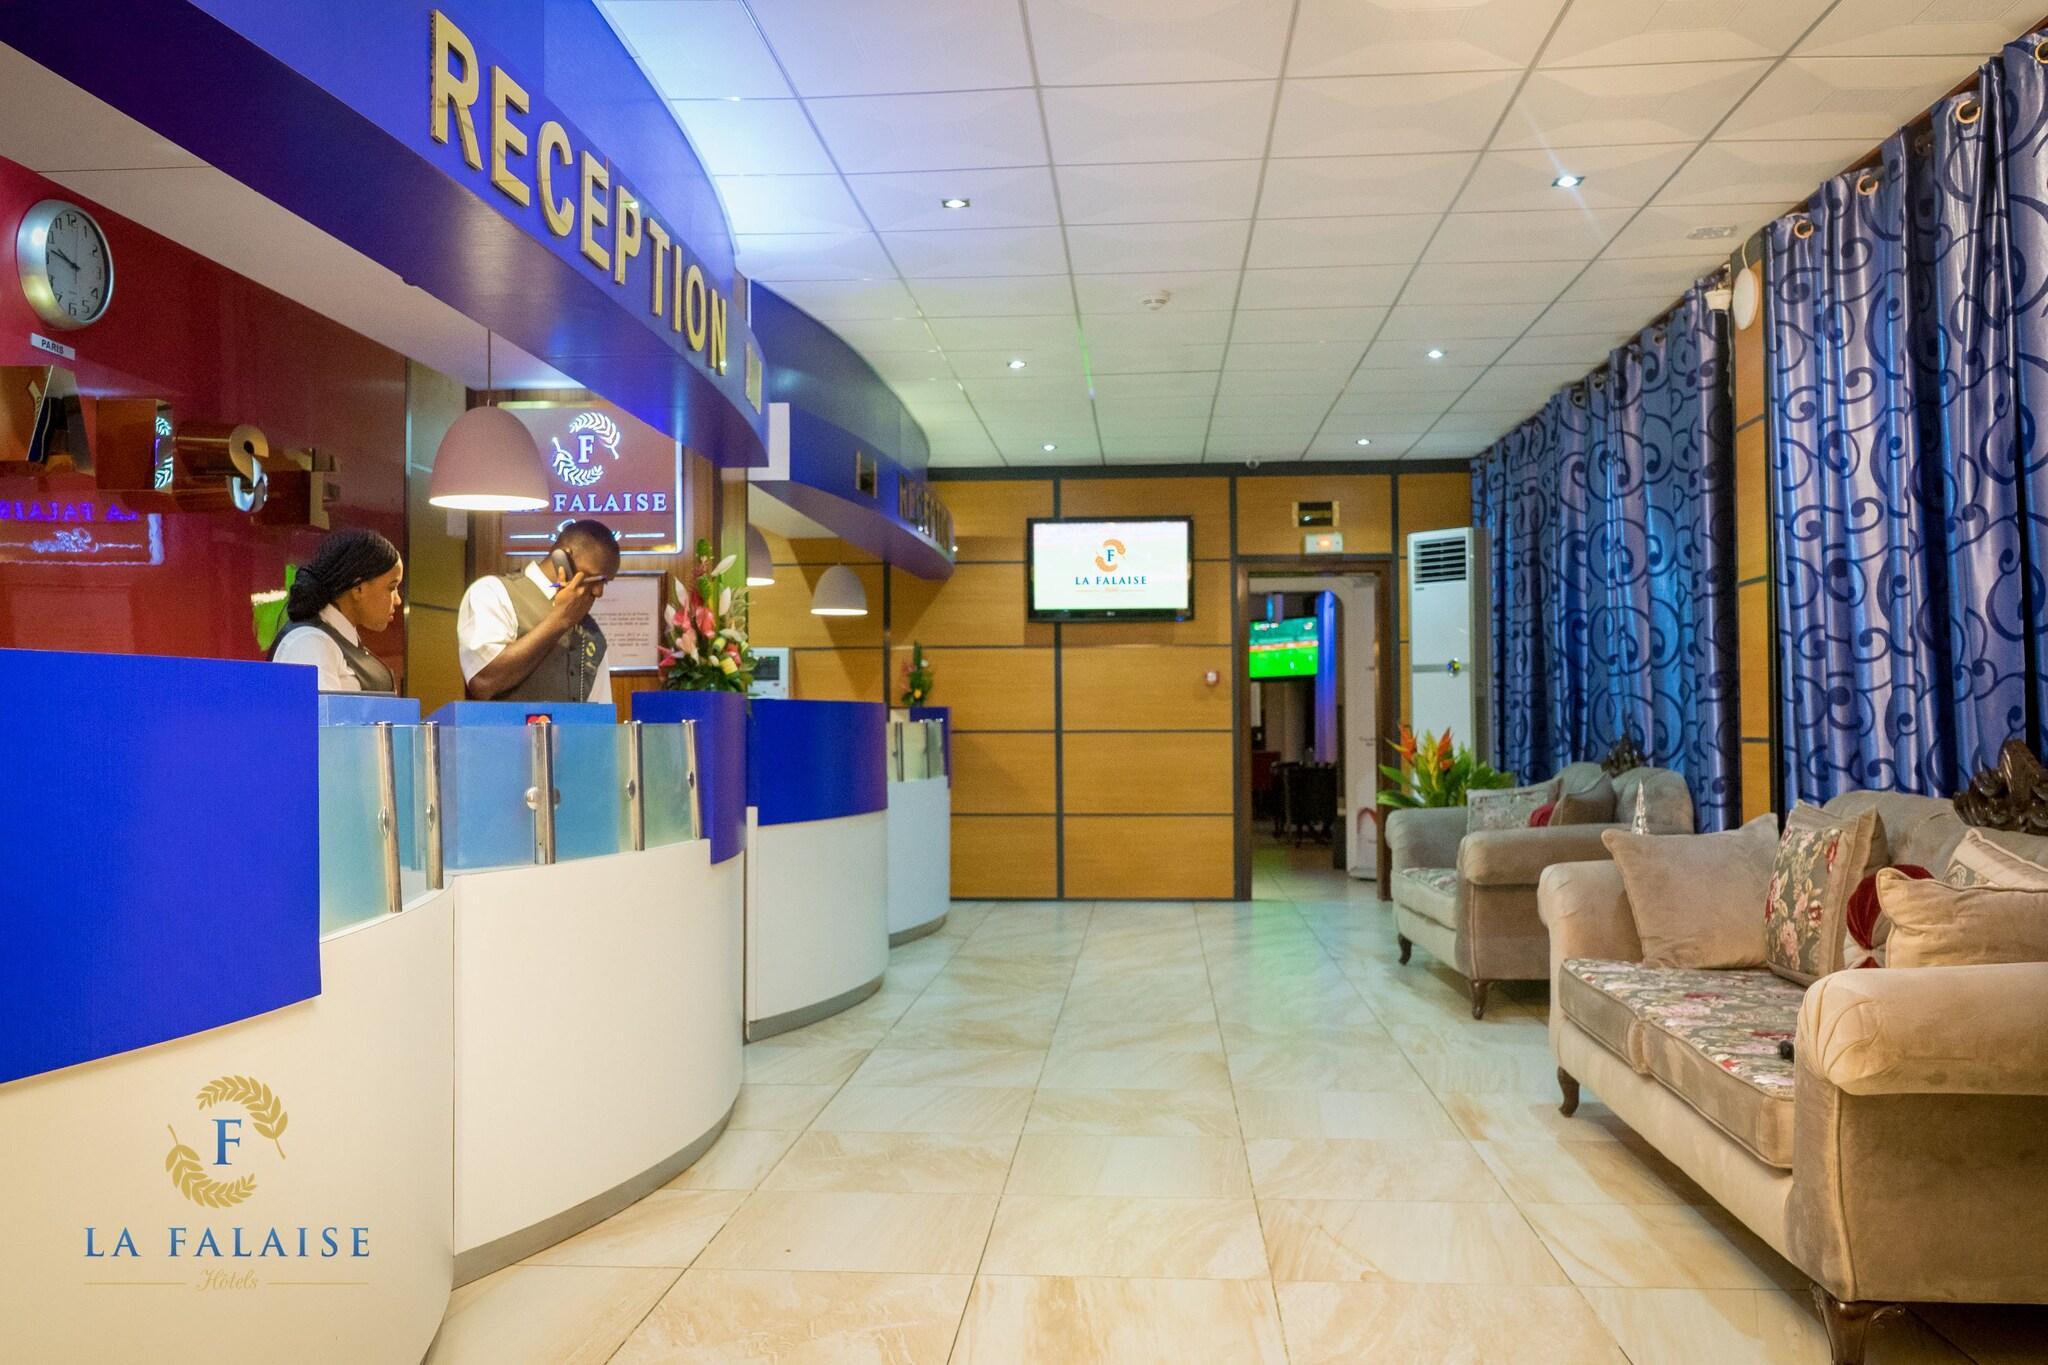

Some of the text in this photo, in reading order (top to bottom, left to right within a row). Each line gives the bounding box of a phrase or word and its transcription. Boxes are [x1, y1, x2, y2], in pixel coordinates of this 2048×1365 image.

[430, 8, 727, 377] RECEPTION
[91, 287, 99, 300] 4
[81, 300, 90, 314] 5
[41, 339, 64, 354] PARIS
[578, 434, 595, 464] F
[553, 493, 667, 513] FALAISE
[1107, 549, 1115, 562] F
[1075, 575, 1147, 585] LA FALAISE
